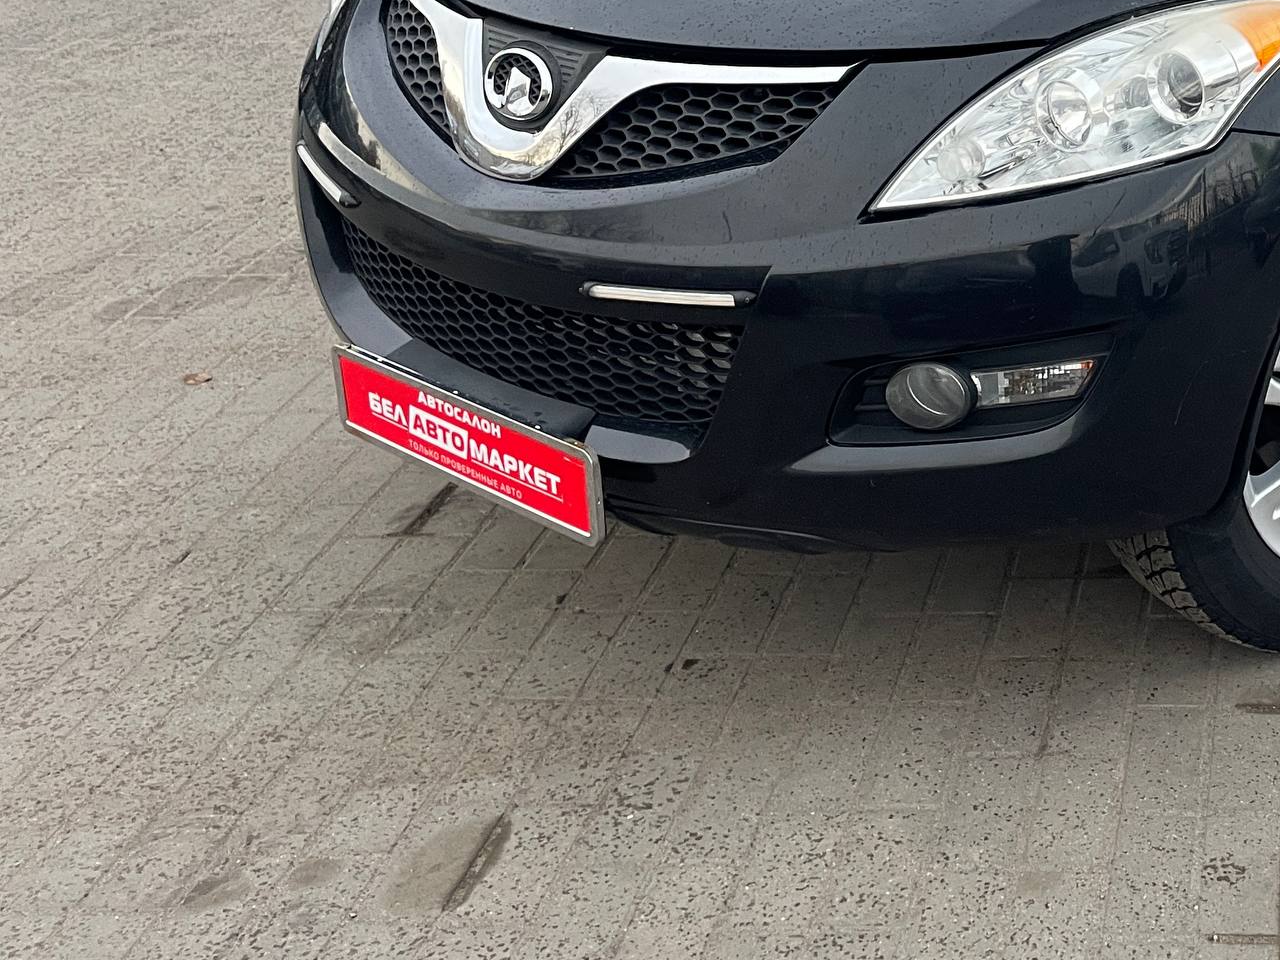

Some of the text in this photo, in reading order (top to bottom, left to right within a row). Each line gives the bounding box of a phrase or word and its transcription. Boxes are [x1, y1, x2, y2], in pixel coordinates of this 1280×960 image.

[368, 391, 561, 495] БЕЛ АВТО МАРКЕТ
[418, 390, 502, 439] АВТОСАЛОН
[407, 439, 523, 500] ТОЛЬКО ПРОВЕРЕННЫЕ АВТО
